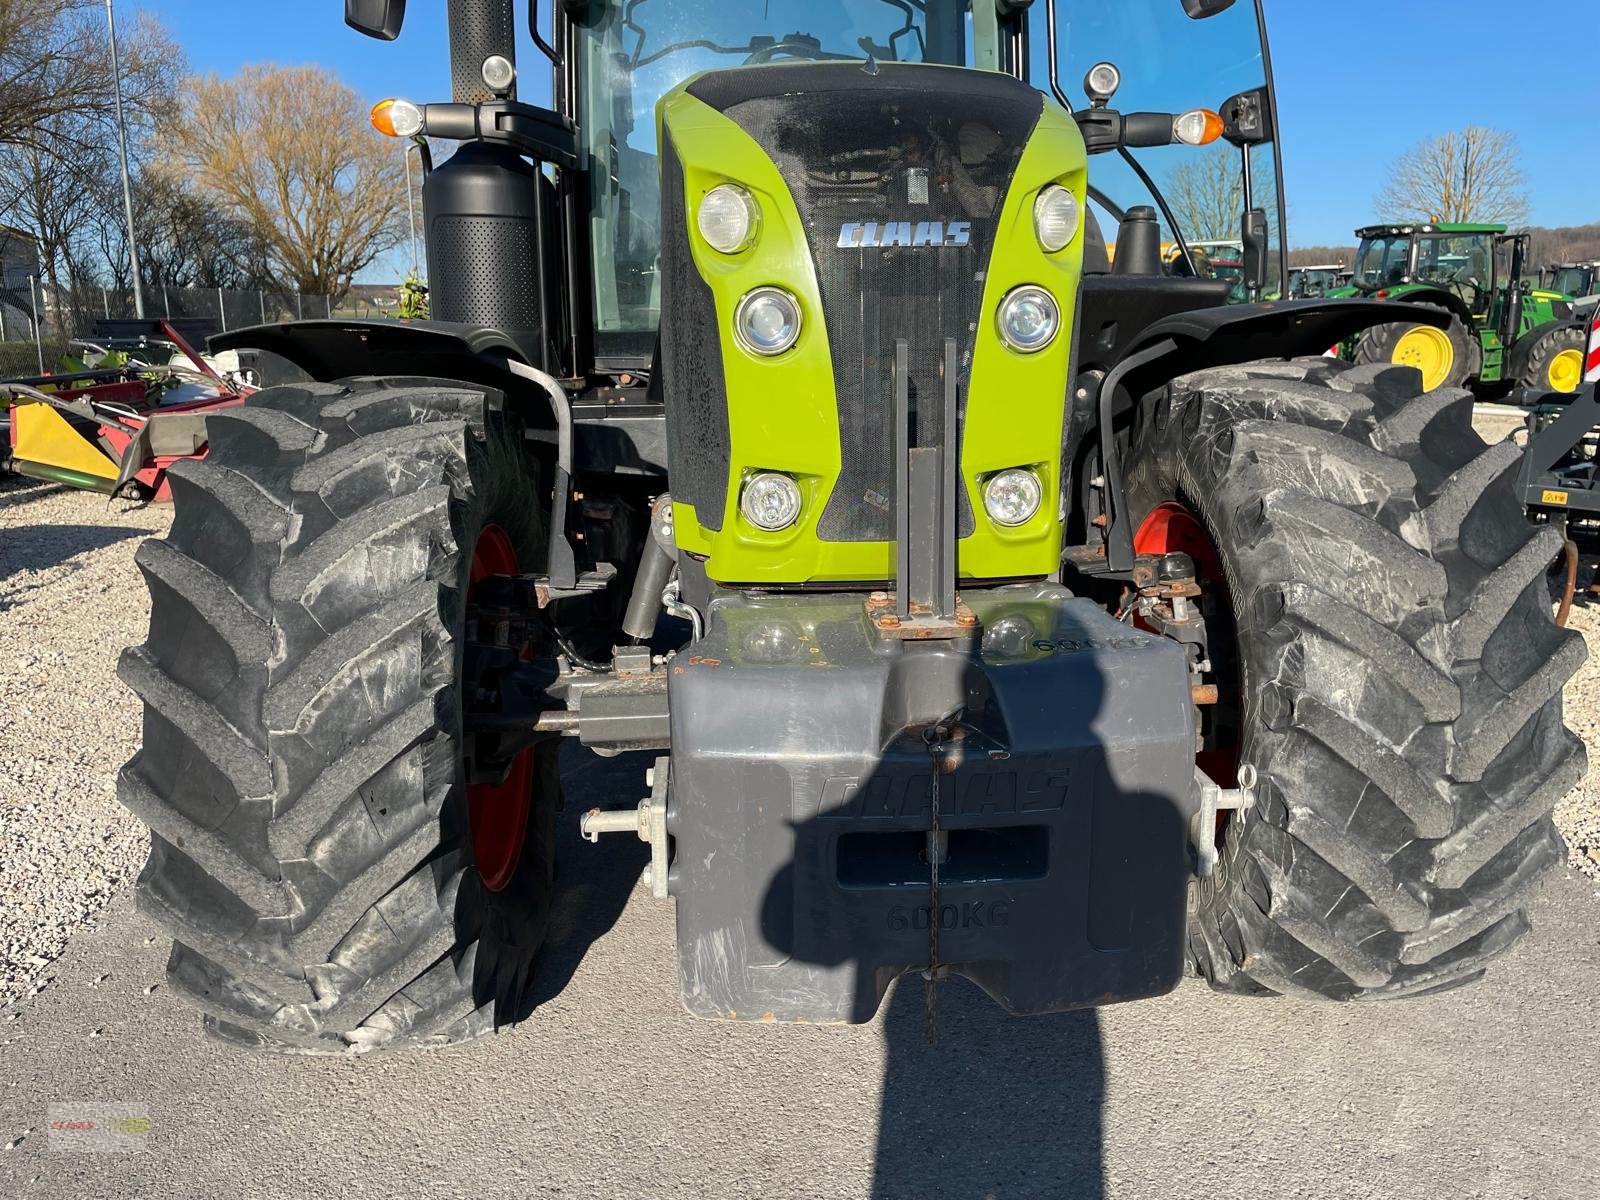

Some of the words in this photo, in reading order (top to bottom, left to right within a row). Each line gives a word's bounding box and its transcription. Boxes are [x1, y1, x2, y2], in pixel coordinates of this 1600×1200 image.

[837, 221, 971, 248] CLAAS
[816, 766, 1070, 820] CLAAS
[887, 899, 1010, 933] 600KG
